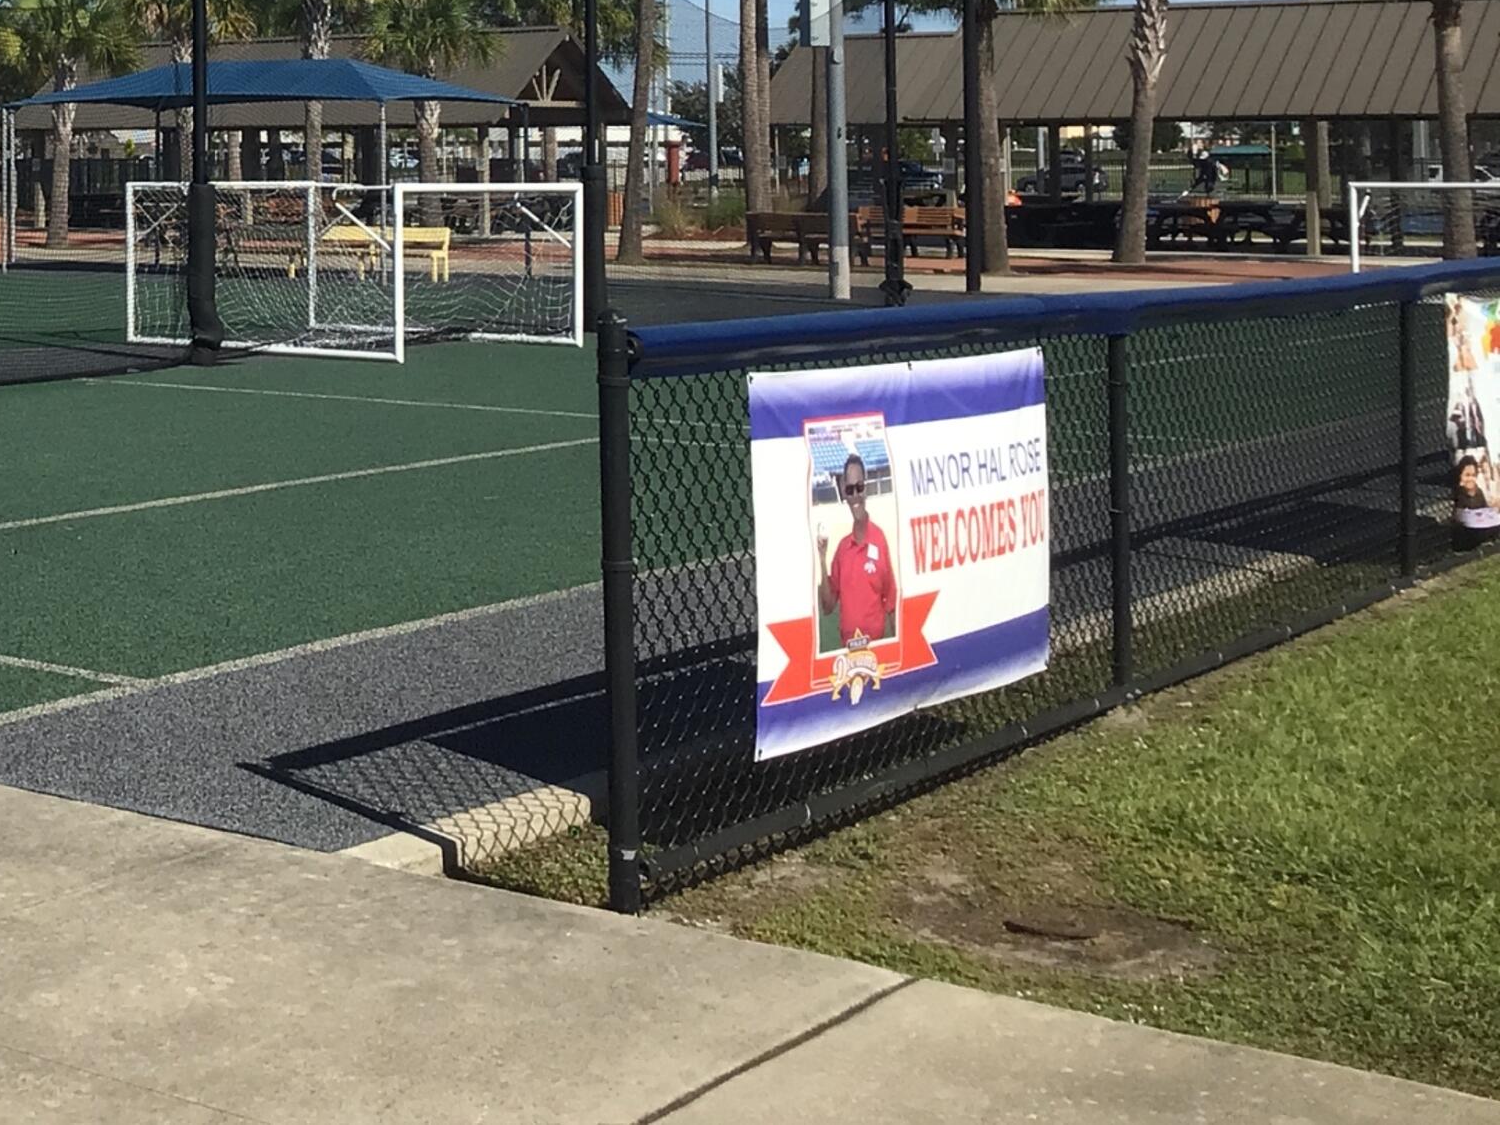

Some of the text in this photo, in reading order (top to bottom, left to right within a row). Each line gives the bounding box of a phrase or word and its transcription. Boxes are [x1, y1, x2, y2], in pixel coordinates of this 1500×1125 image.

[909, 437, 1040, 496] MAYOR HAL ROSE
[909, 488, 1045, 575] WELCOMES YOU
